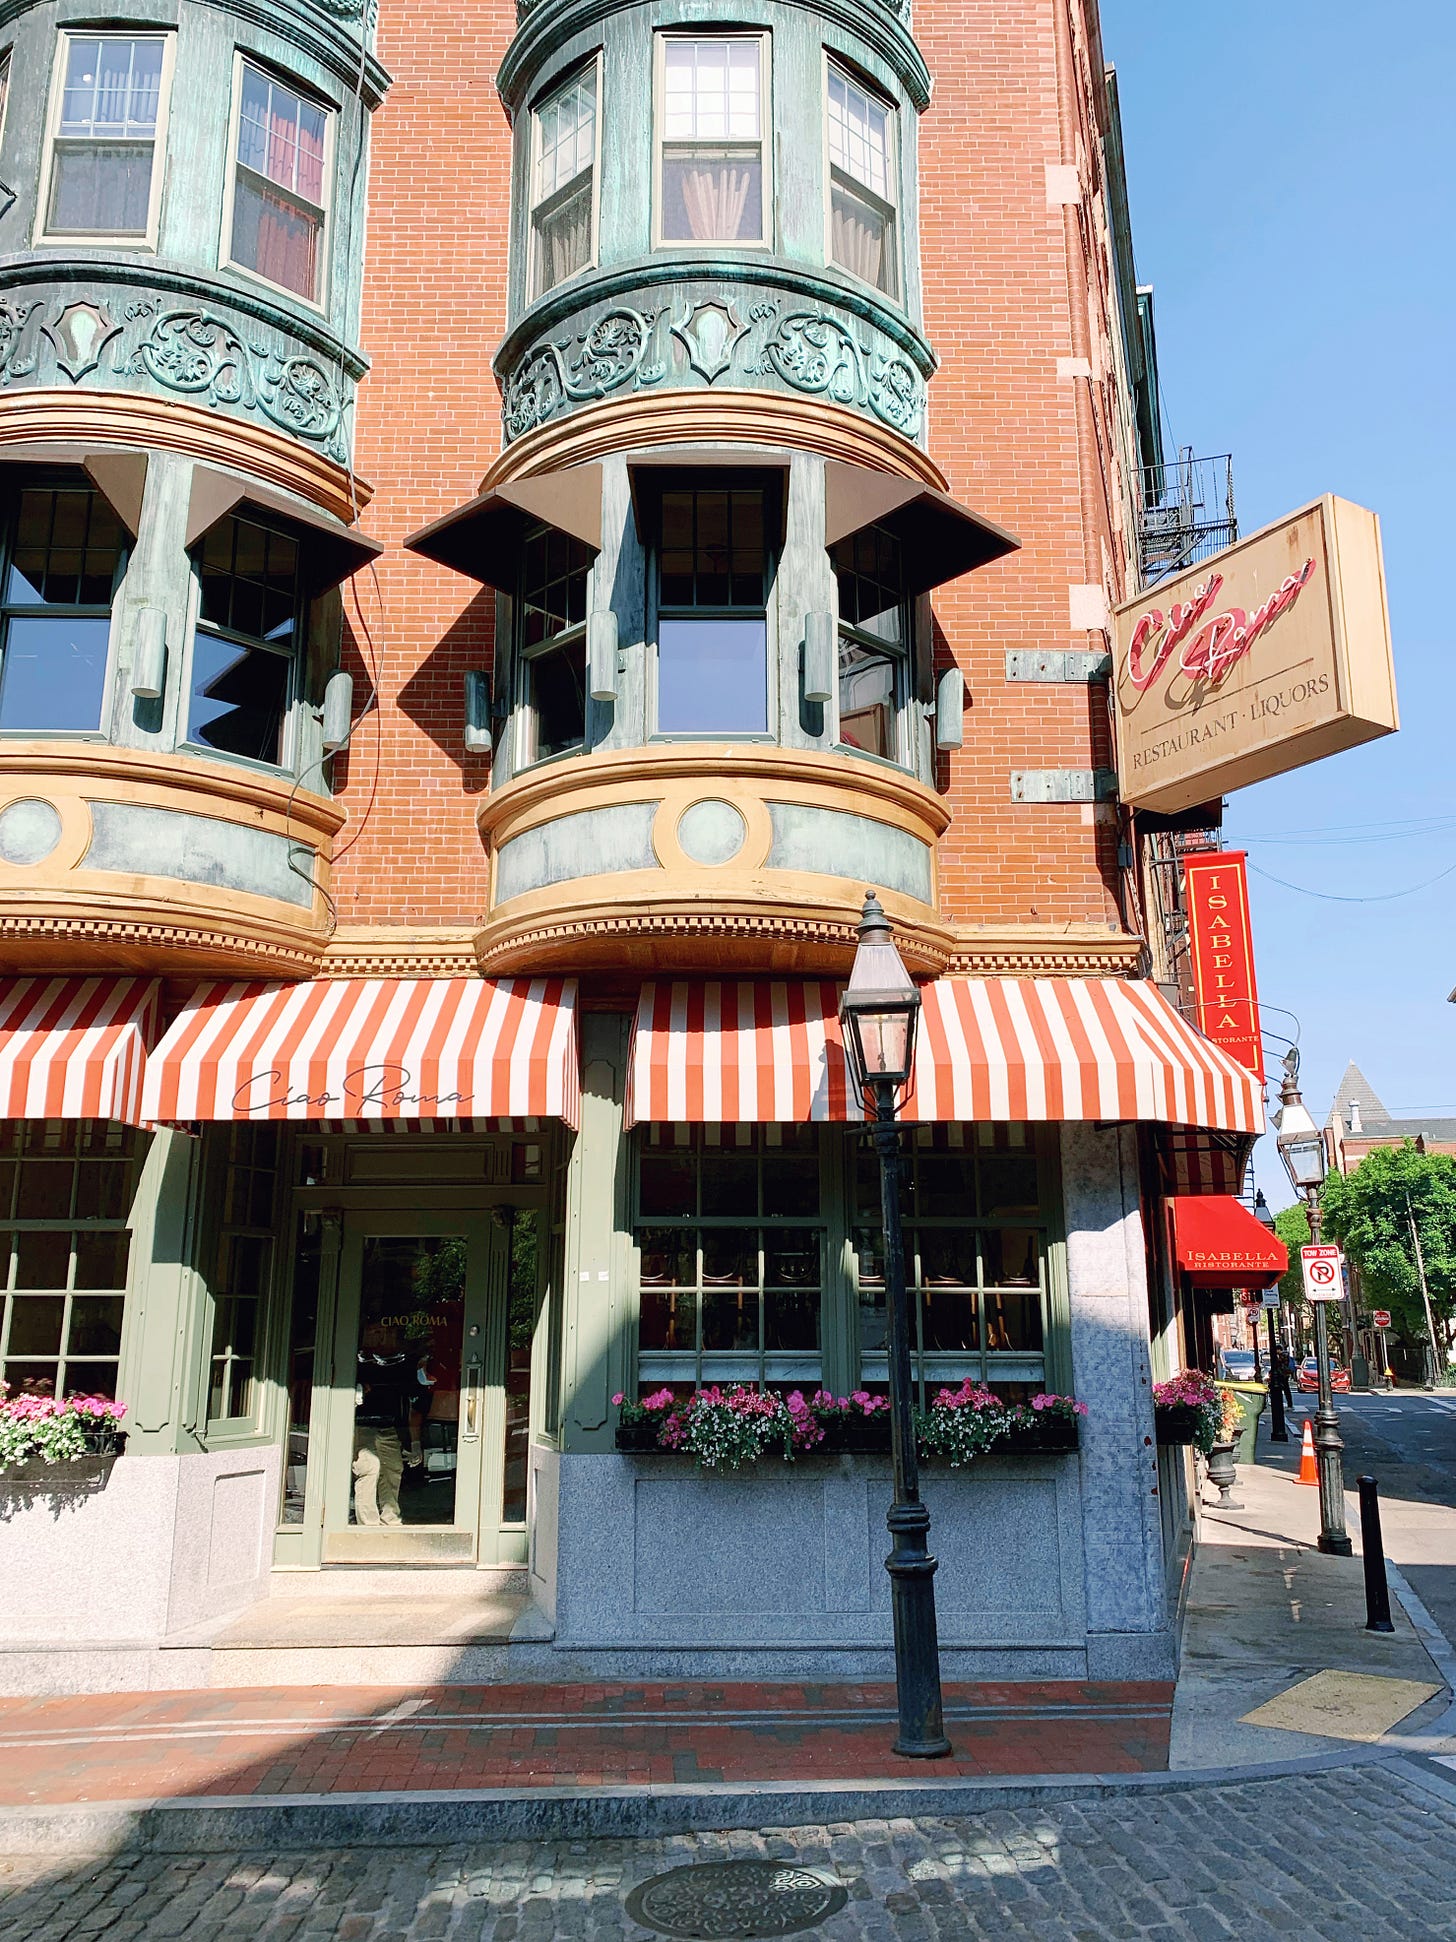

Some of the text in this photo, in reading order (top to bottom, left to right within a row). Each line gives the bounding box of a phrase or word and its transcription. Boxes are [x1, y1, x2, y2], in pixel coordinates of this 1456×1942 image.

[1127, 572, 1224, 691] Ciao
[1179, 556, 1317, 684] Roma
[1132, 672, 1330, 770] RESTAURANT LIQUORS
[1207, 875, 1241, 1029] ISABELLA
[1211, 1035, 1260, 1044] STORANTE
[232, 1064, 475, 1116] Ciao Roma
[1303, 1248, 1337, 1257] TOW ZONE
[380, 1314, 448, 1327] CIAO ROMA
